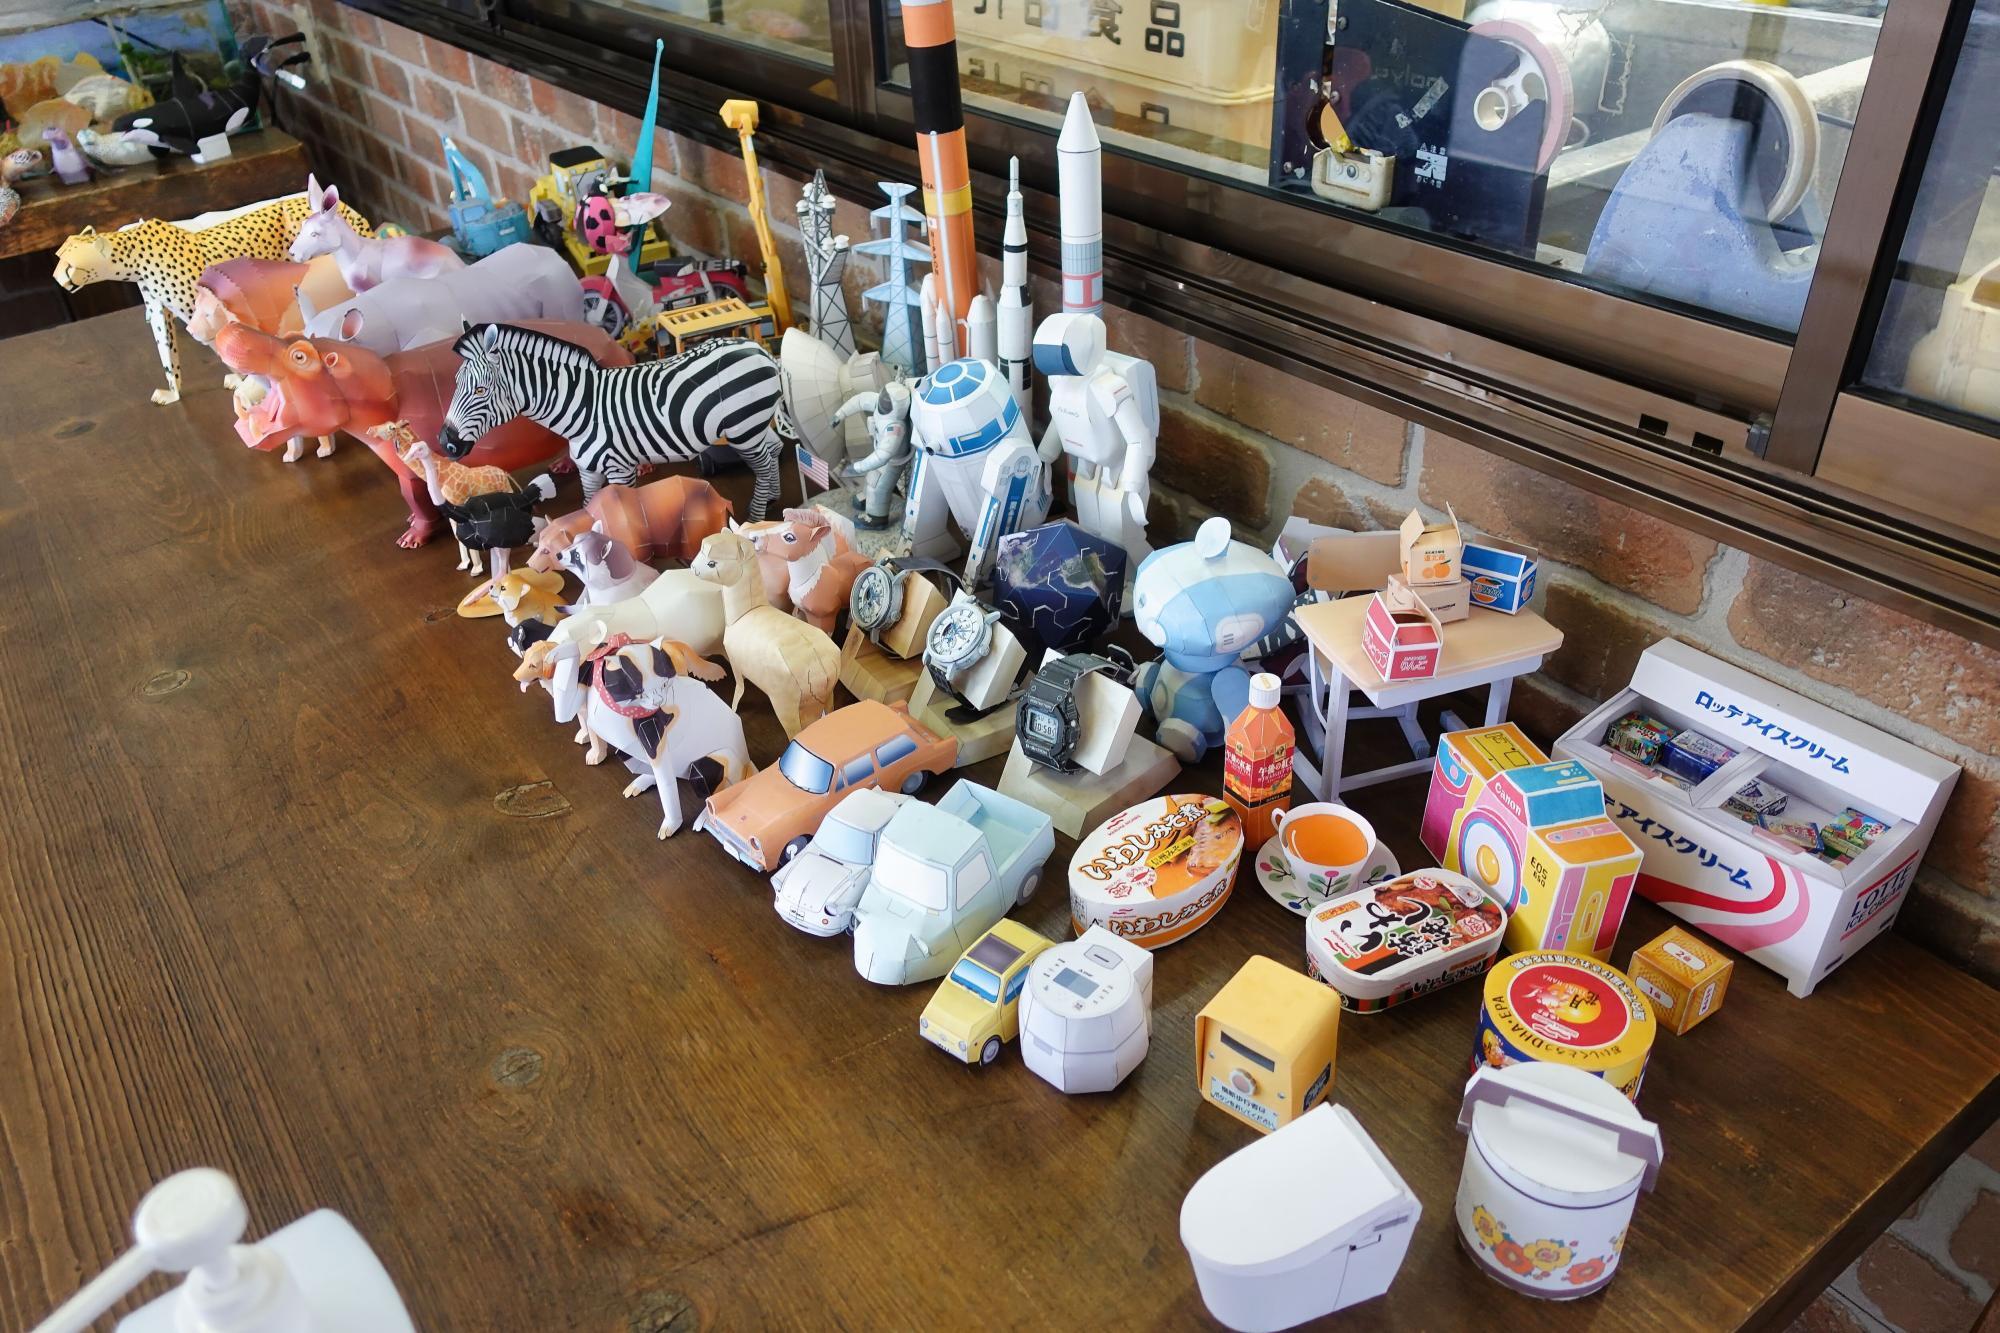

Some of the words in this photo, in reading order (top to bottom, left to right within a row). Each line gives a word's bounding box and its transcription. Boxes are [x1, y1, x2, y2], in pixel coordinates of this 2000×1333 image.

[1494, 782, 1522, 817] Canon
[1530, 856, 1549, 880] EOS
[1851, 863, 1912, 918] LOTTE
[1339, 895, 1432, 953] いわし
